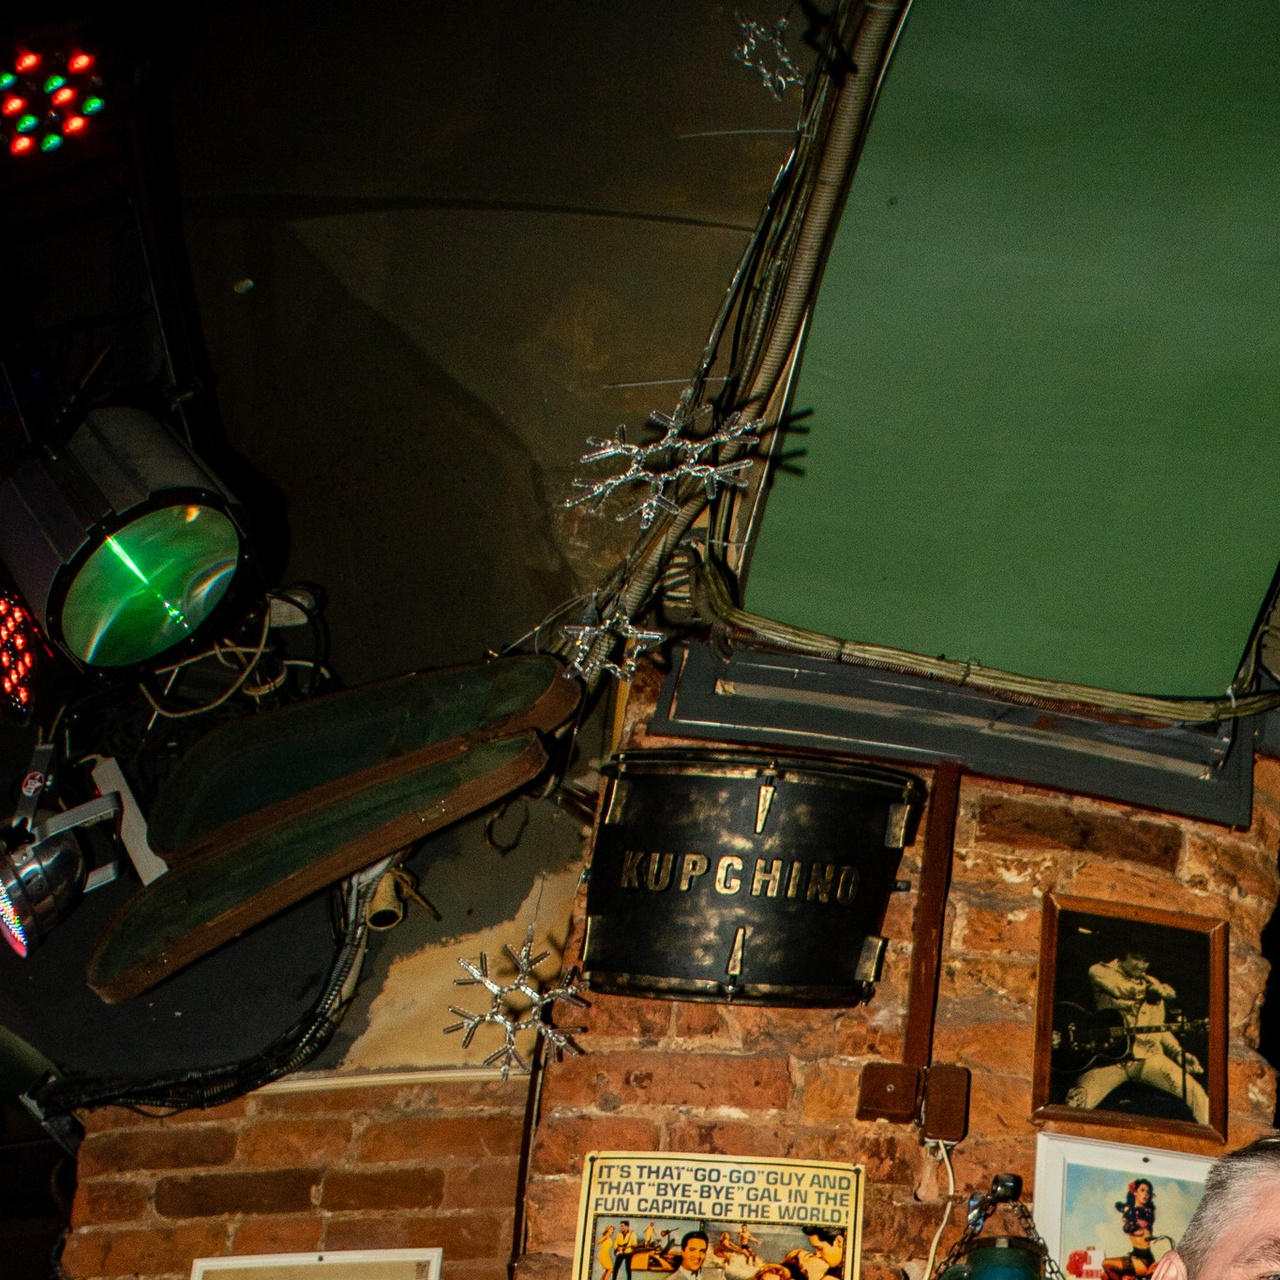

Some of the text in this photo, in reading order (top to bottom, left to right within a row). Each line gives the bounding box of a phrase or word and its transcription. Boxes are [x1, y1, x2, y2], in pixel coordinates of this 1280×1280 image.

[620, 850, 861, 905] KUPCHINO
[598, 1164, 631, 1179] IT'S
[636, 1165, 683, 1181] THAT
[766, 1172, 805, 1187] GUY
[809, 1174, 851, 1190] AND
[597, 1181, 645, 1195] THAT
[746, 1187, 781, 1203] GAL
[788, 1190, 808, 1204] IN
[815, 1191, 850, 1207] THE
[594, 1198, 629, 1212] FUN
[637, 1199, 706, 1216] CAPITAL
[711, 1202, 733, 1217] OF
[740, 1204, 770, 1219] THE
